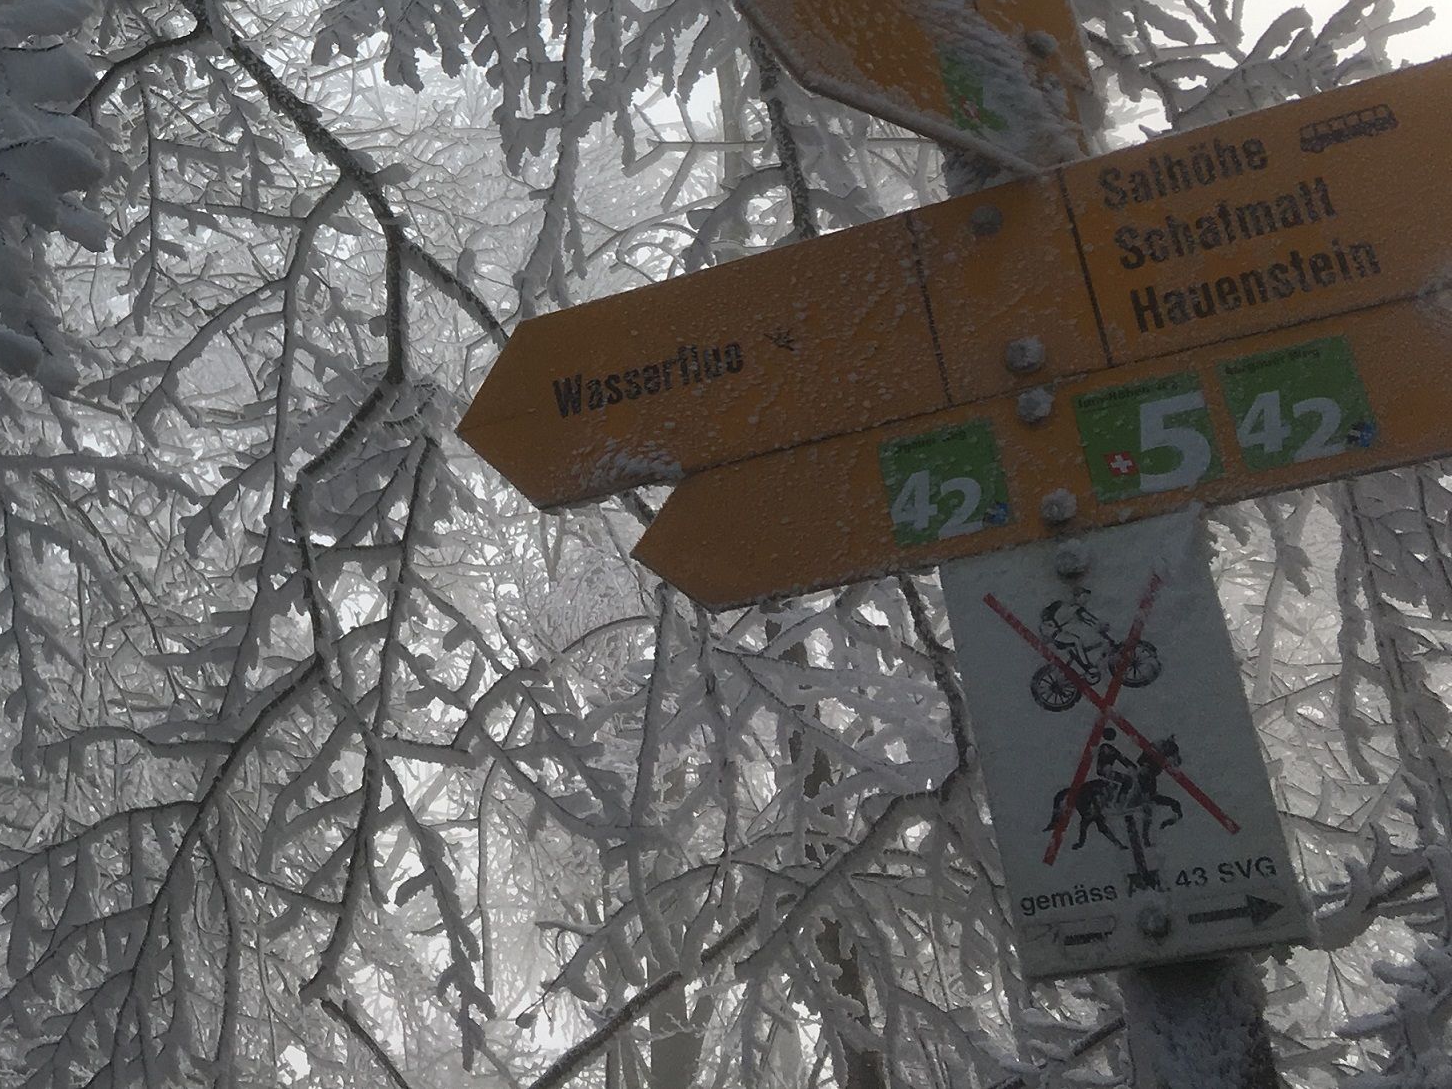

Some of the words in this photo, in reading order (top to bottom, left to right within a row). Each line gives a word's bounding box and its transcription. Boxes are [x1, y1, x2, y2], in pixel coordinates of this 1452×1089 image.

[1098, 137, 1268, 208] Salhöhe
[1114, 177, 1337, 269] Schafmatt
[1129, 238, 1382, 332] Hauenstein
[1140, 391, 1211, 492] 5
[1237, 390, 1347, 462] 42
[890, 470, 982, 540] 42
[1020, 883, 1117, 915] gemäss
[1175, 866, 1208, 888] 43
[1218, 856, 1277, 884] SVG
